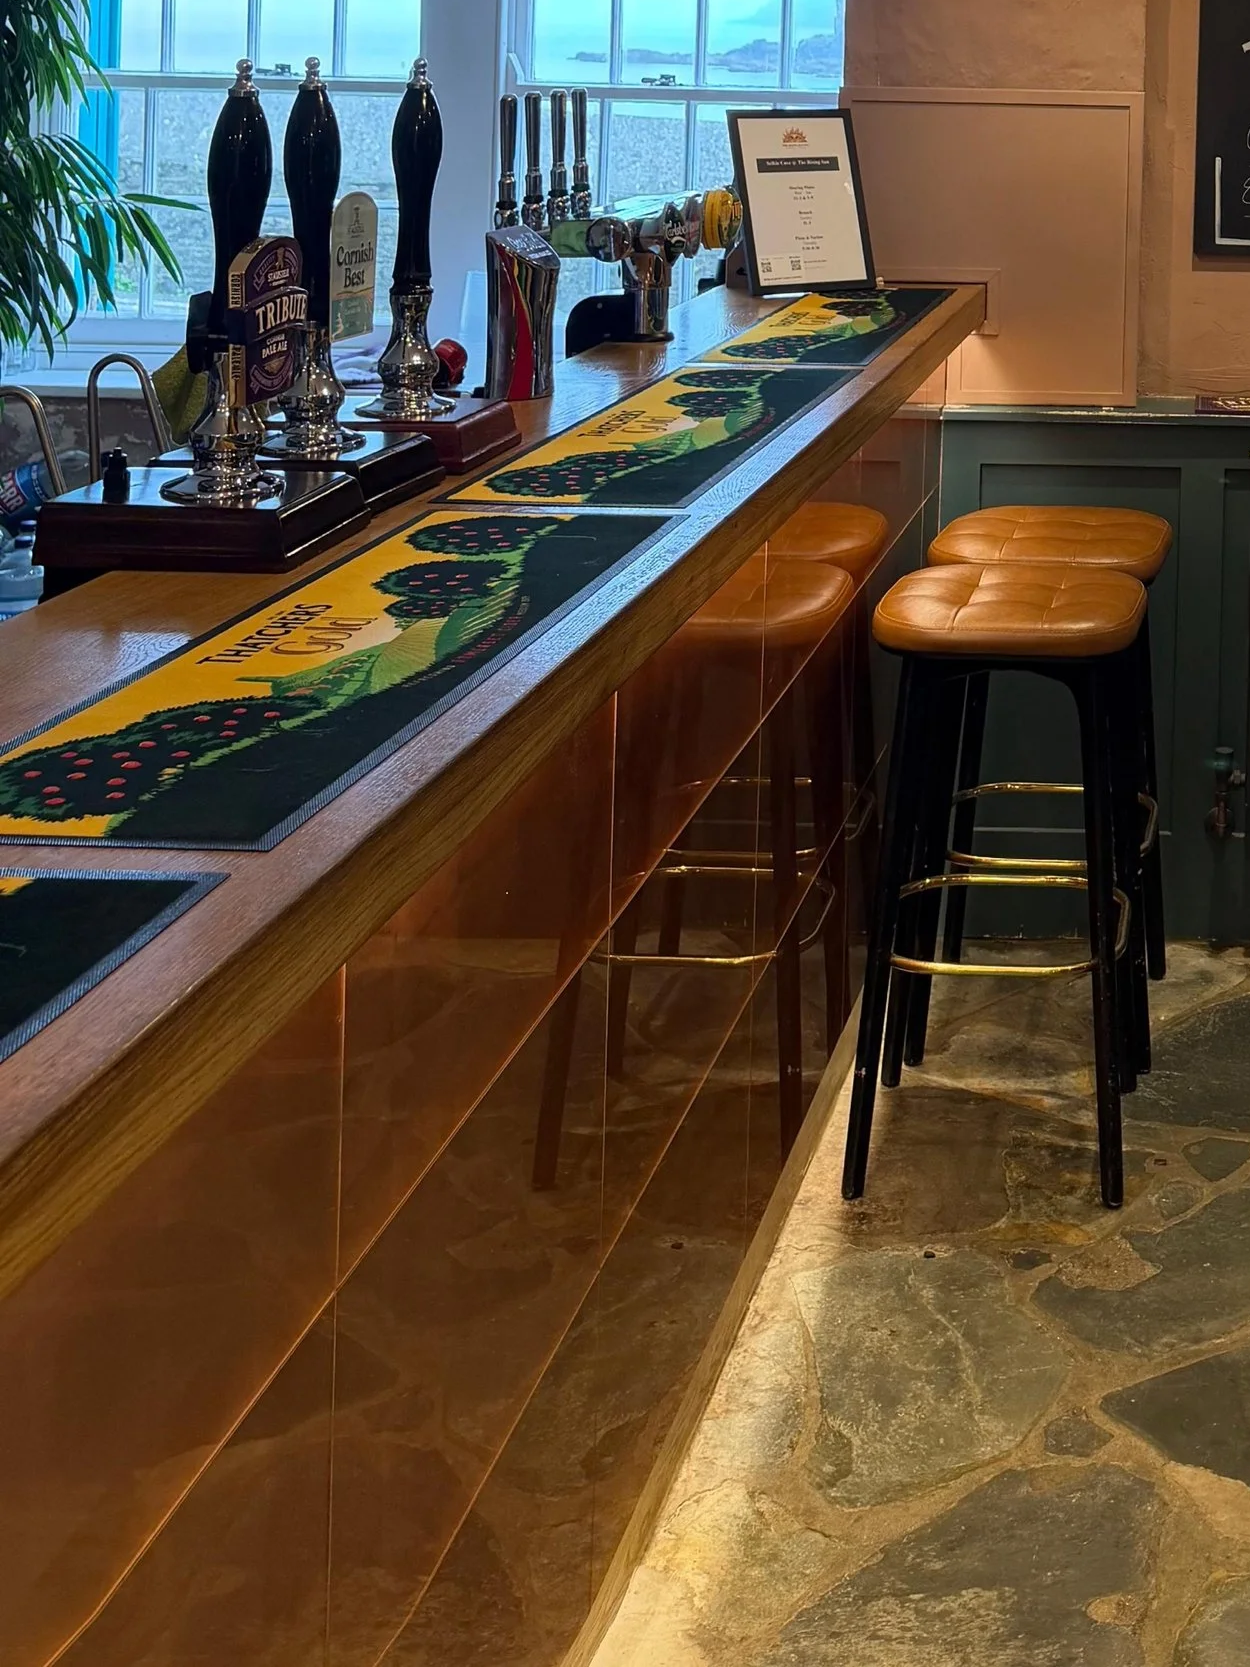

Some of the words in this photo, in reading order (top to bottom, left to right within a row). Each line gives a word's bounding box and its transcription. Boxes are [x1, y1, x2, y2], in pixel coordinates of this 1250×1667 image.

[336, 241, 374, 267] Cornish
[344, 267, 365, 288] Best
[255, 293, 308, 334] TRIBUTE
[262, 343, 277, 358] PALE
[277, 340, 288, 352] ALE
[195, 603, 333, 665] THATCHERS
[270, 615, 379, 656] Gold
